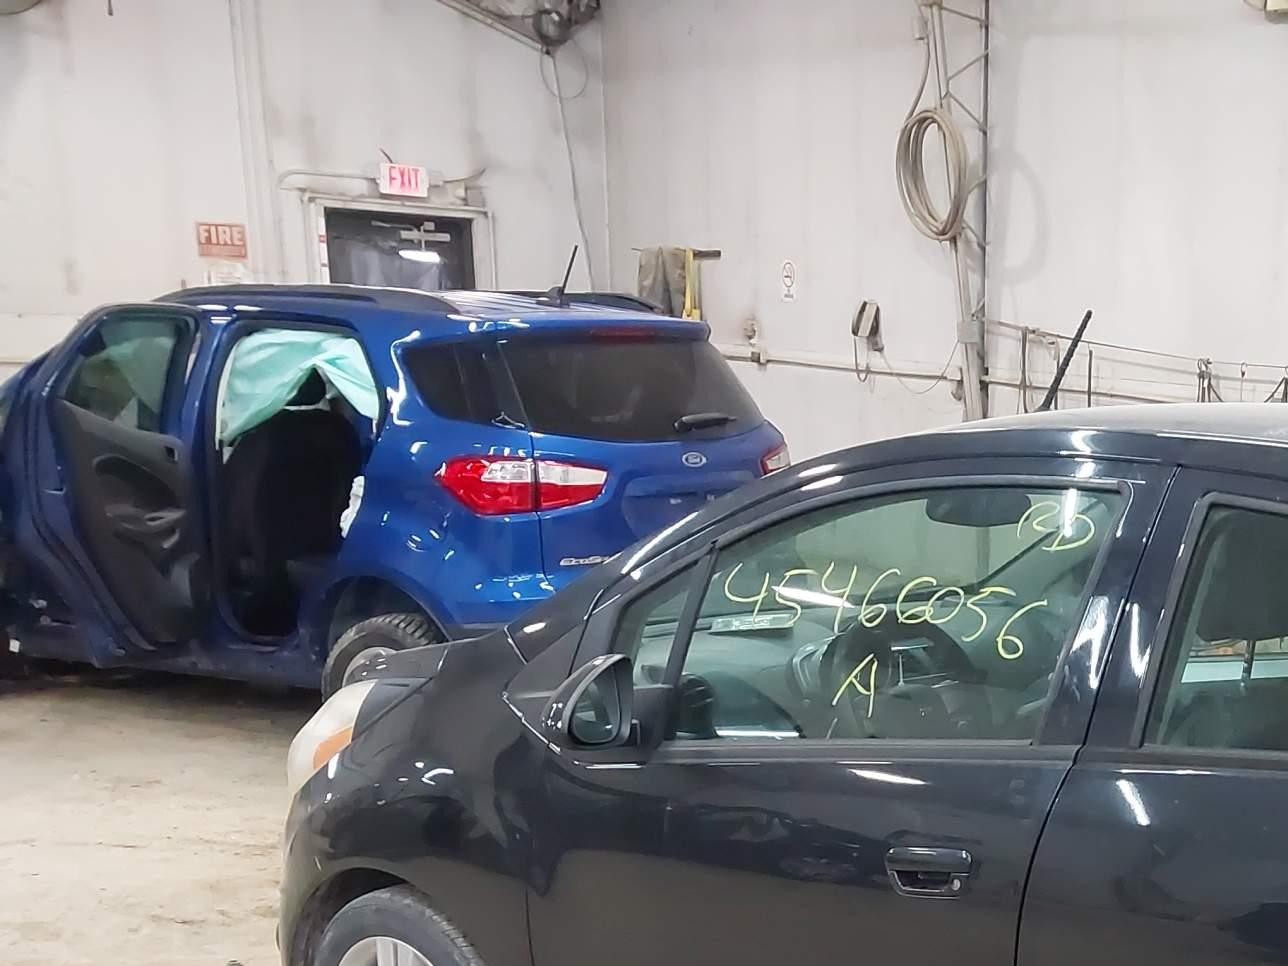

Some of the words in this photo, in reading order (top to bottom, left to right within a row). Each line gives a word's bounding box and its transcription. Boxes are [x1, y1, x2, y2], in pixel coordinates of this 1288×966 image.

[388, 165, 420, 191] EXIT
[199, 225, 244, 246] FIRE
[724, 560, 1048, 660] 45466056
